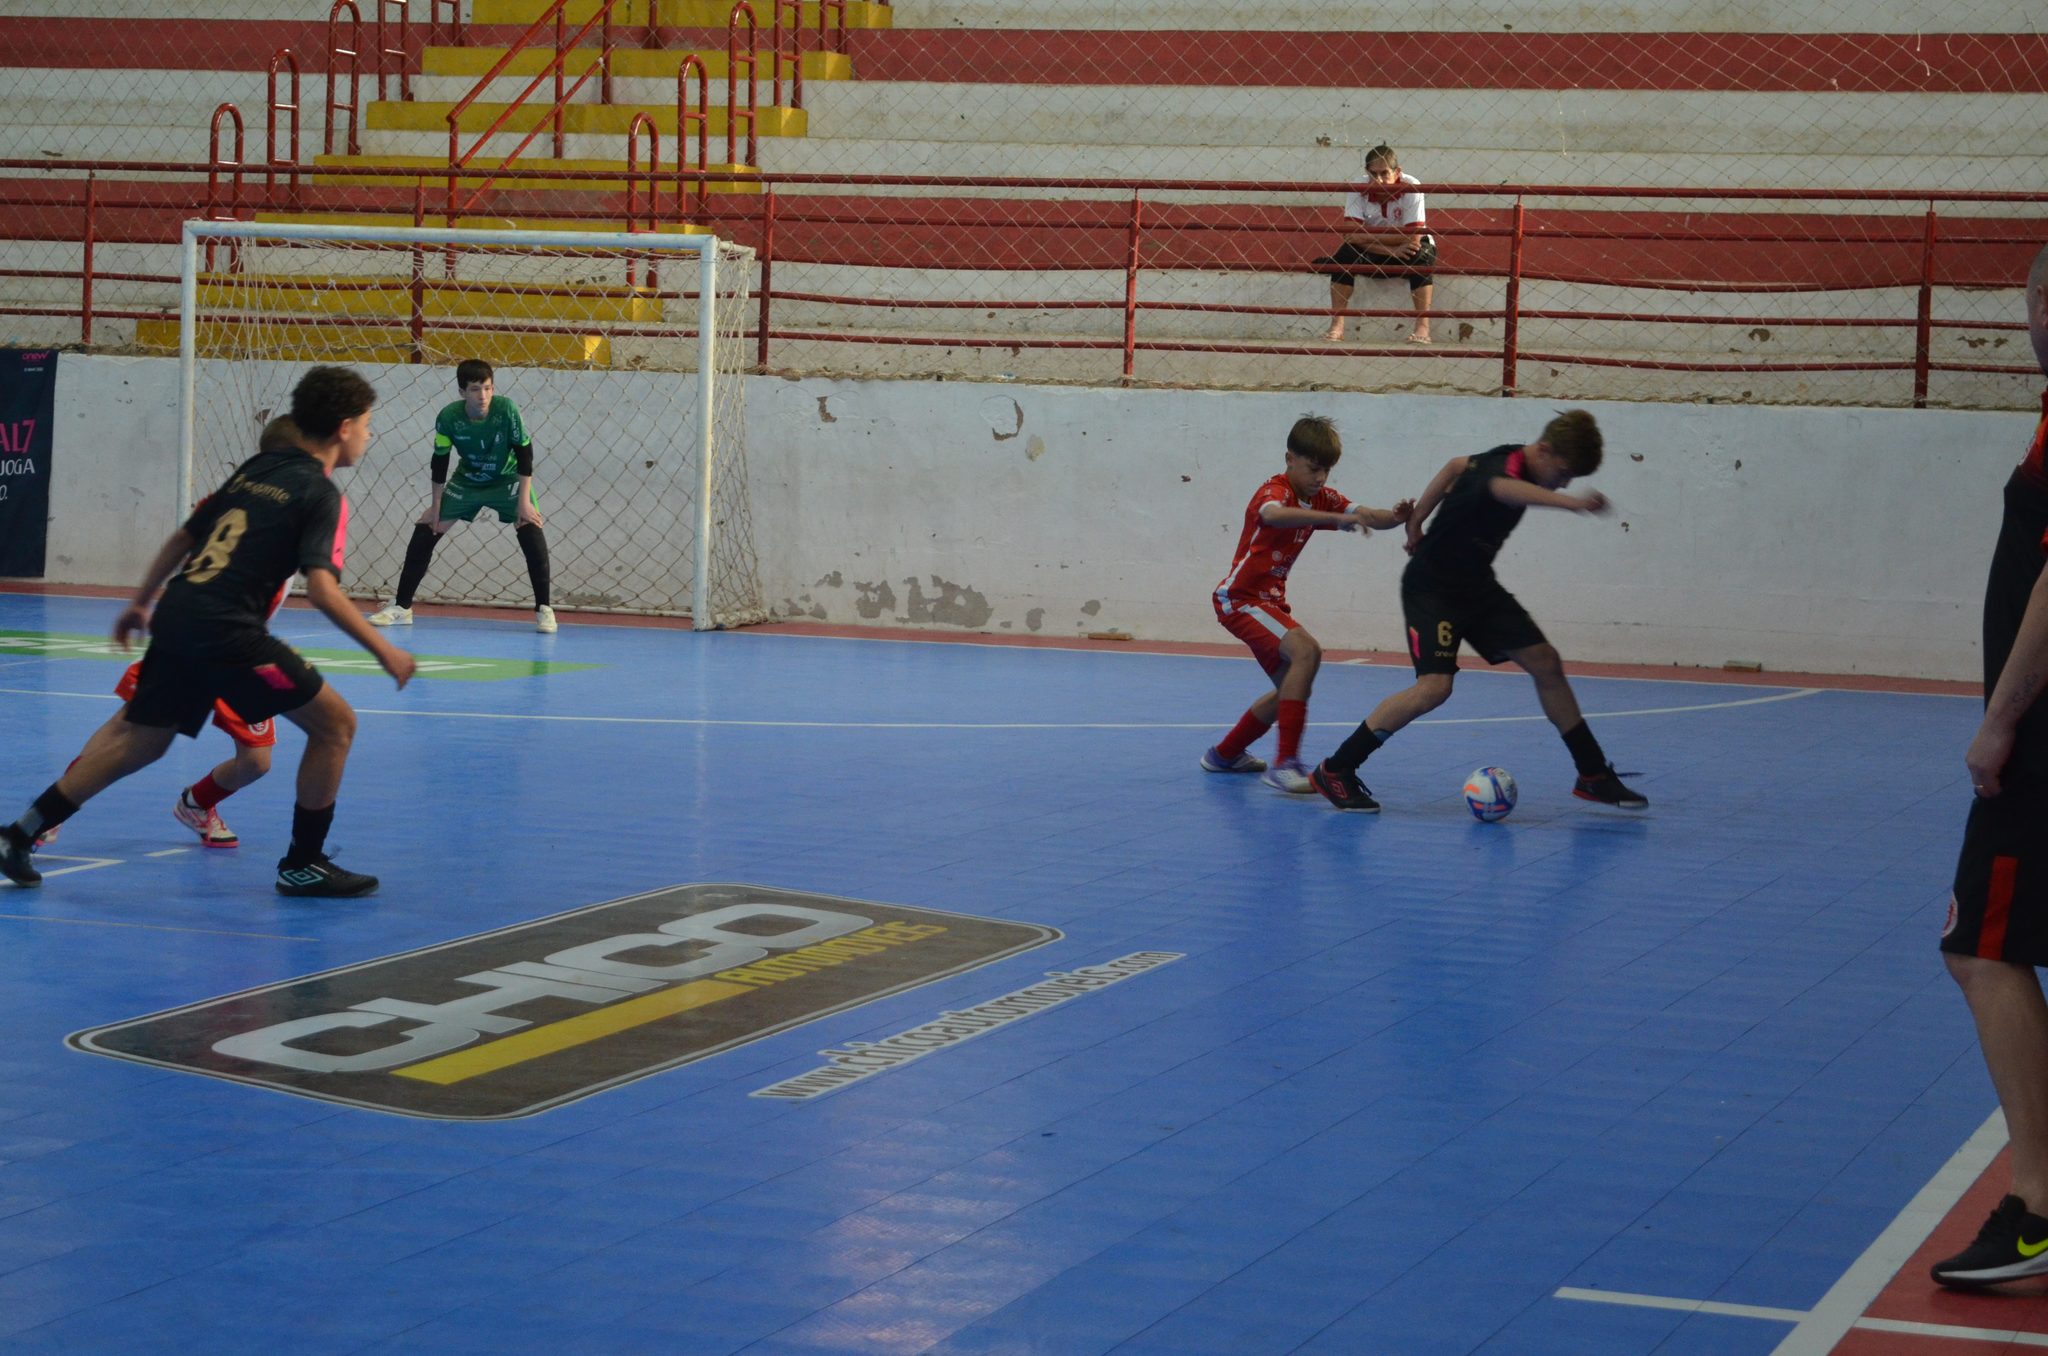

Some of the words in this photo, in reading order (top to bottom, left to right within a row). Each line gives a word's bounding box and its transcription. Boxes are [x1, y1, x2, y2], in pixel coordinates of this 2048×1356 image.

[183, 507, 248, 584] 8
[1437, 620, 1453, 647] 6
[212, 903, 874, 1073] CHICO
[755, 950, 1182, 1098] www.chicoautomoveis.com
